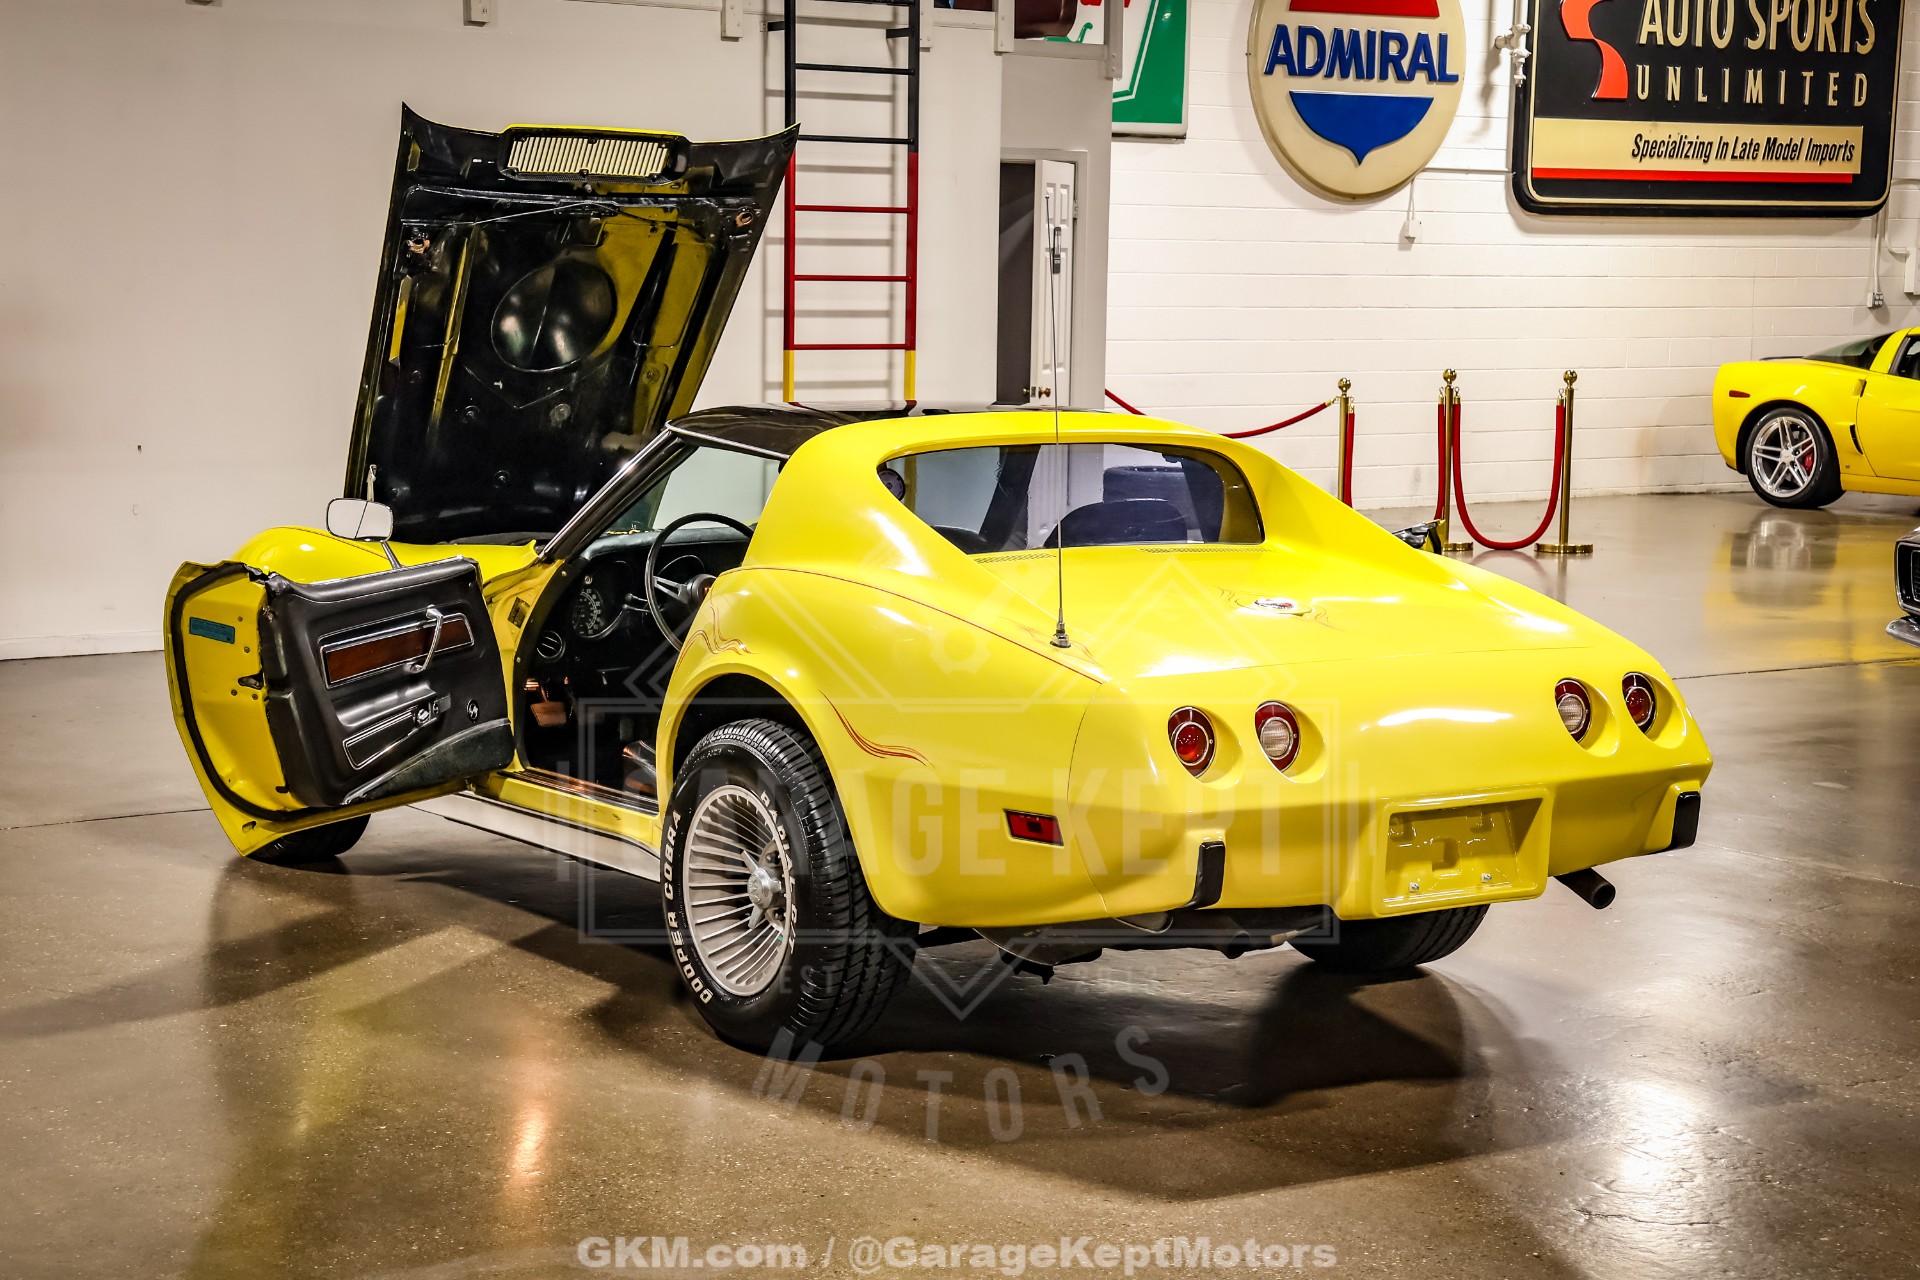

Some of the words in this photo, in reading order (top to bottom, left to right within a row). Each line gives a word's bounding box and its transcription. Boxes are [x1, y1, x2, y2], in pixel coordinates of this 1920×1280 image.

[1264, 24, 1459, 82] ADMIRAL
[1636, 64, 1868, 107] UNLIMITED
[1632, 133, 1713, 164] Specializing
[1715, 135, 1729, 159] In
[1730, 136, 1760, 160] Late
[1762, 137, 1804, 161] Model
[1804, 138, 1855, 165] Imports
[664, 809, 682, 901] COBRA
[666, 910, 714, 1005] COOPER
